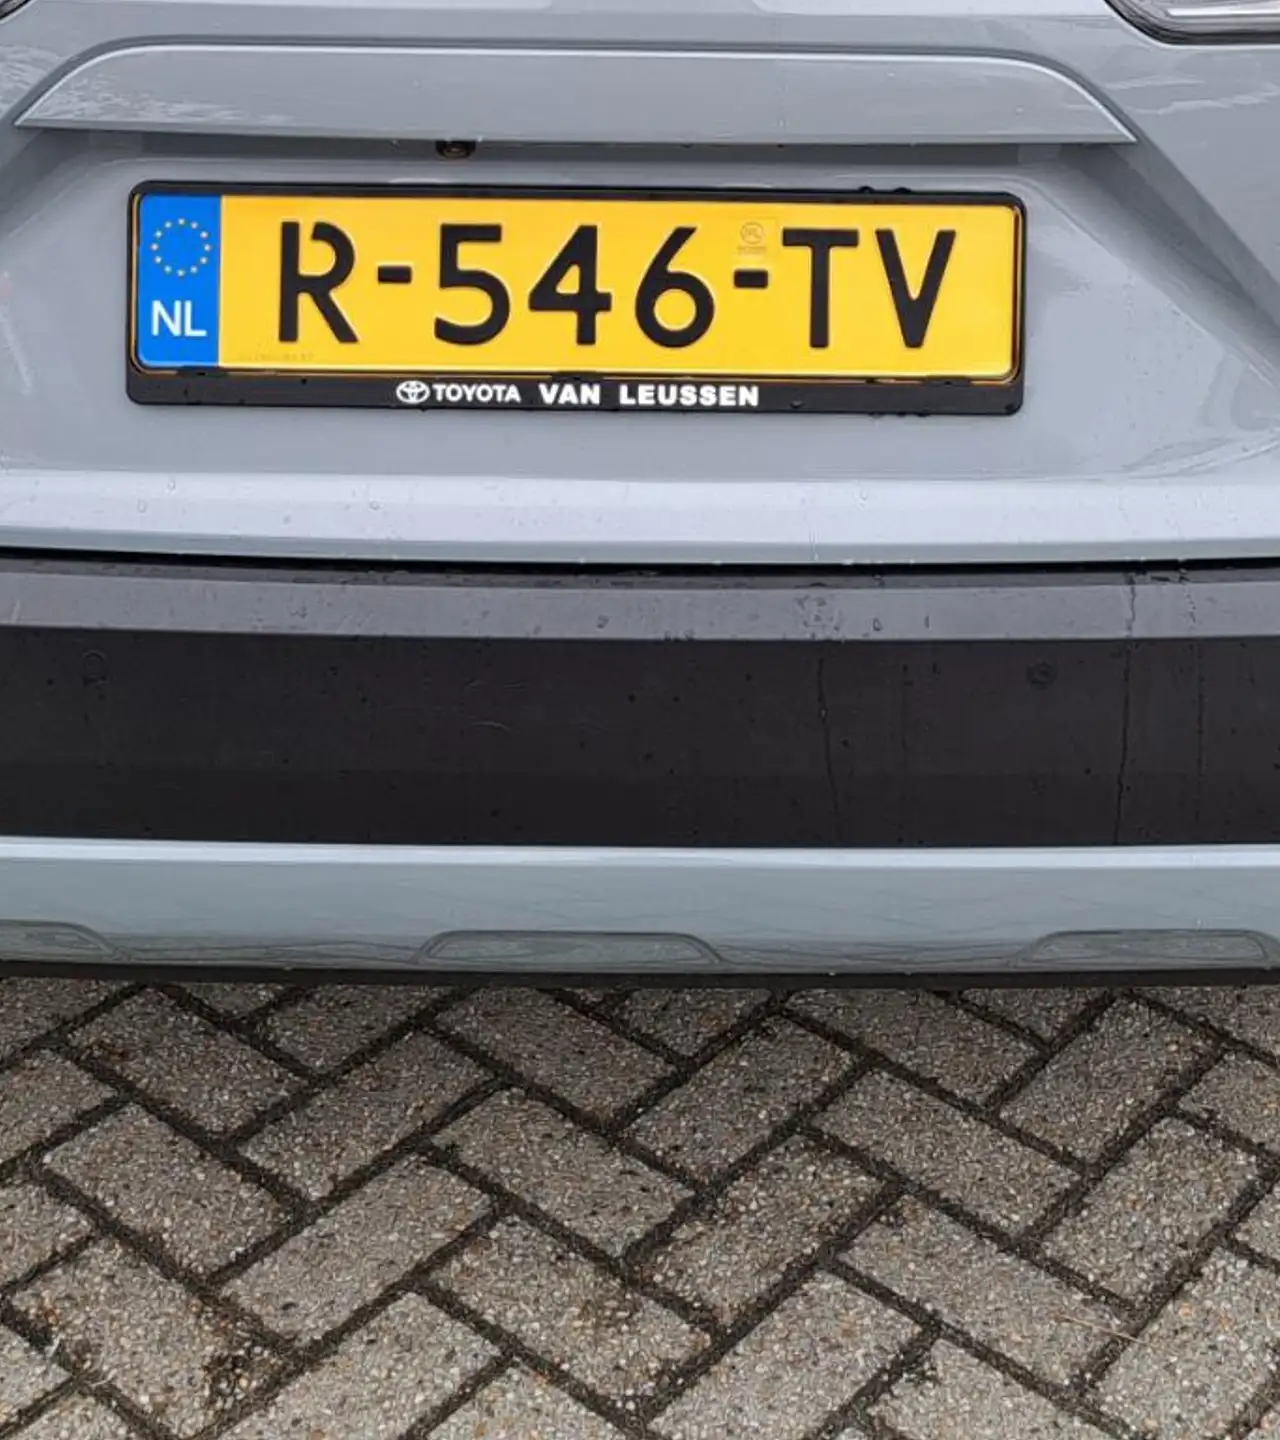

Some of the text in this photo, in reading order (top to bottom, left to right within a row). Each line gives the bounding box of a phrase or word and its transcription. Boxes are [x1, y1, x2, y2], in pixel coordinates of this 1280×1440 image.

[277, 220, 958, 349] R-546-TV
[151, 299, 208, 337] NL
[433, 382, 760, 408] TOYOTA VAN LEUSSEN
